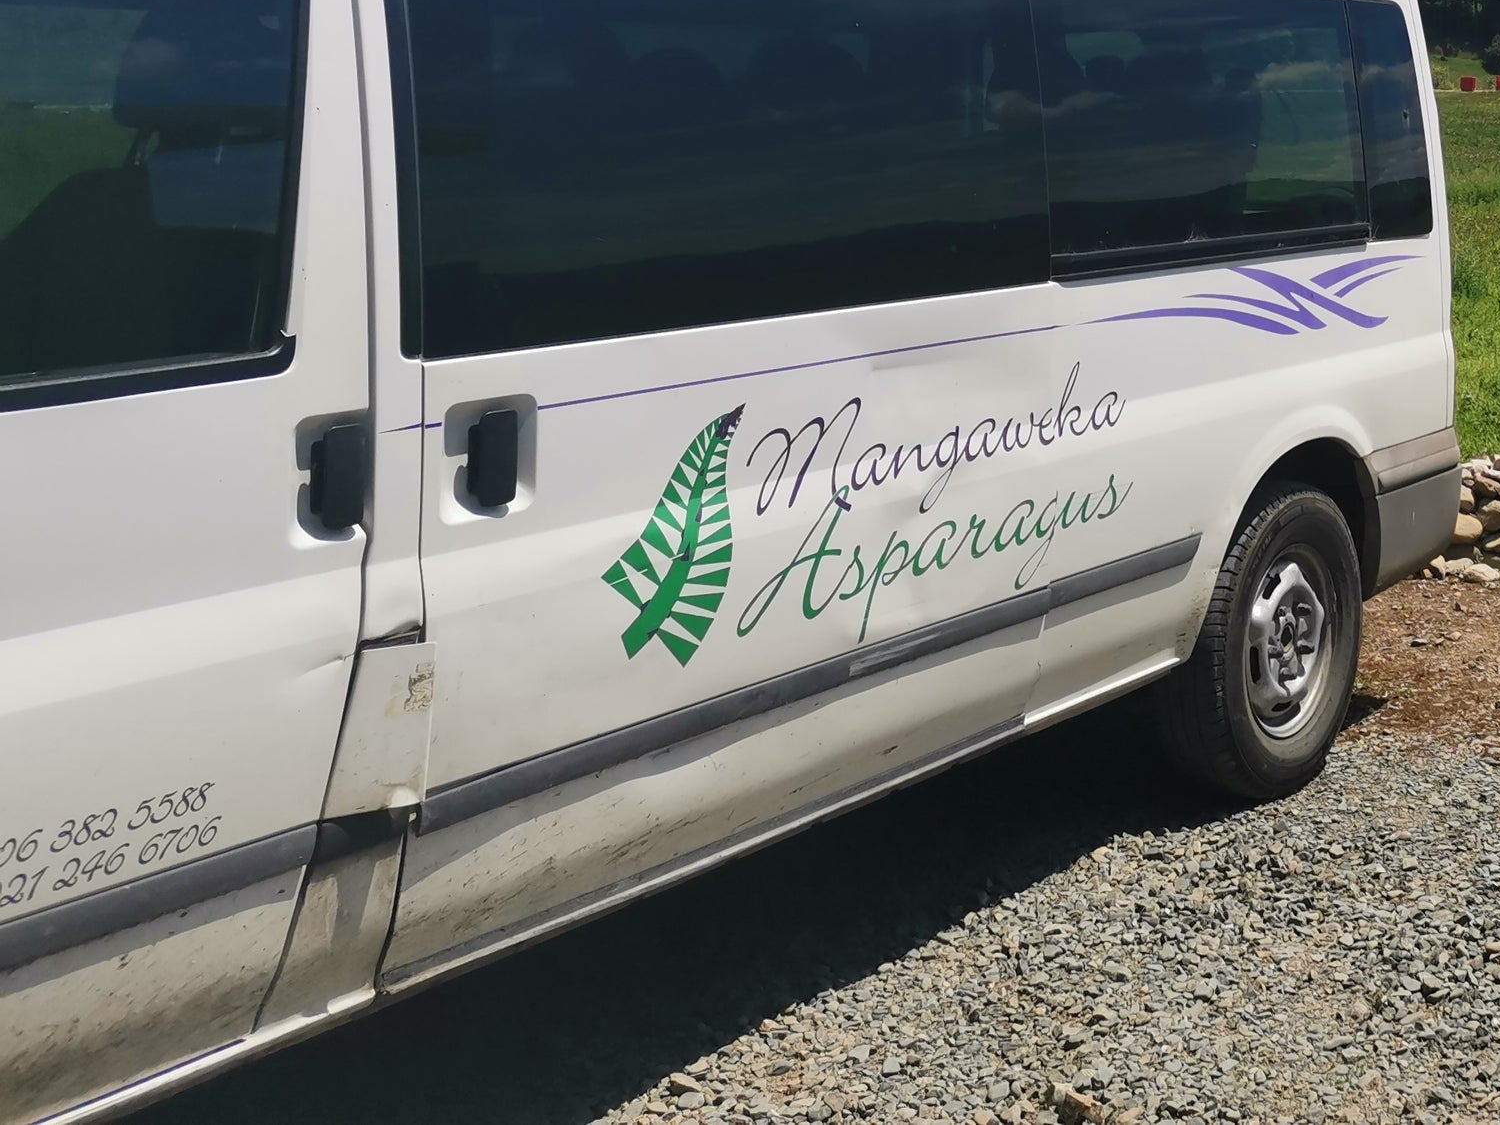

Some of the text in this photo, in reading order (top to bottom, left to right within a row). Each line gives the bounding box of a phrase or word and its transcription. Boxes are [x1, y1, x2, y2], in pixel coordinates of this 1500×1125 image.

[745, 360, 1127, 516] Mangaweka
[736, 473, 1134, 644] Asparagus
[0, 816, 222, 908] 21 246 6706
[50, 808, 118, 853] 382
[127, 782, 216, 831] 5588
